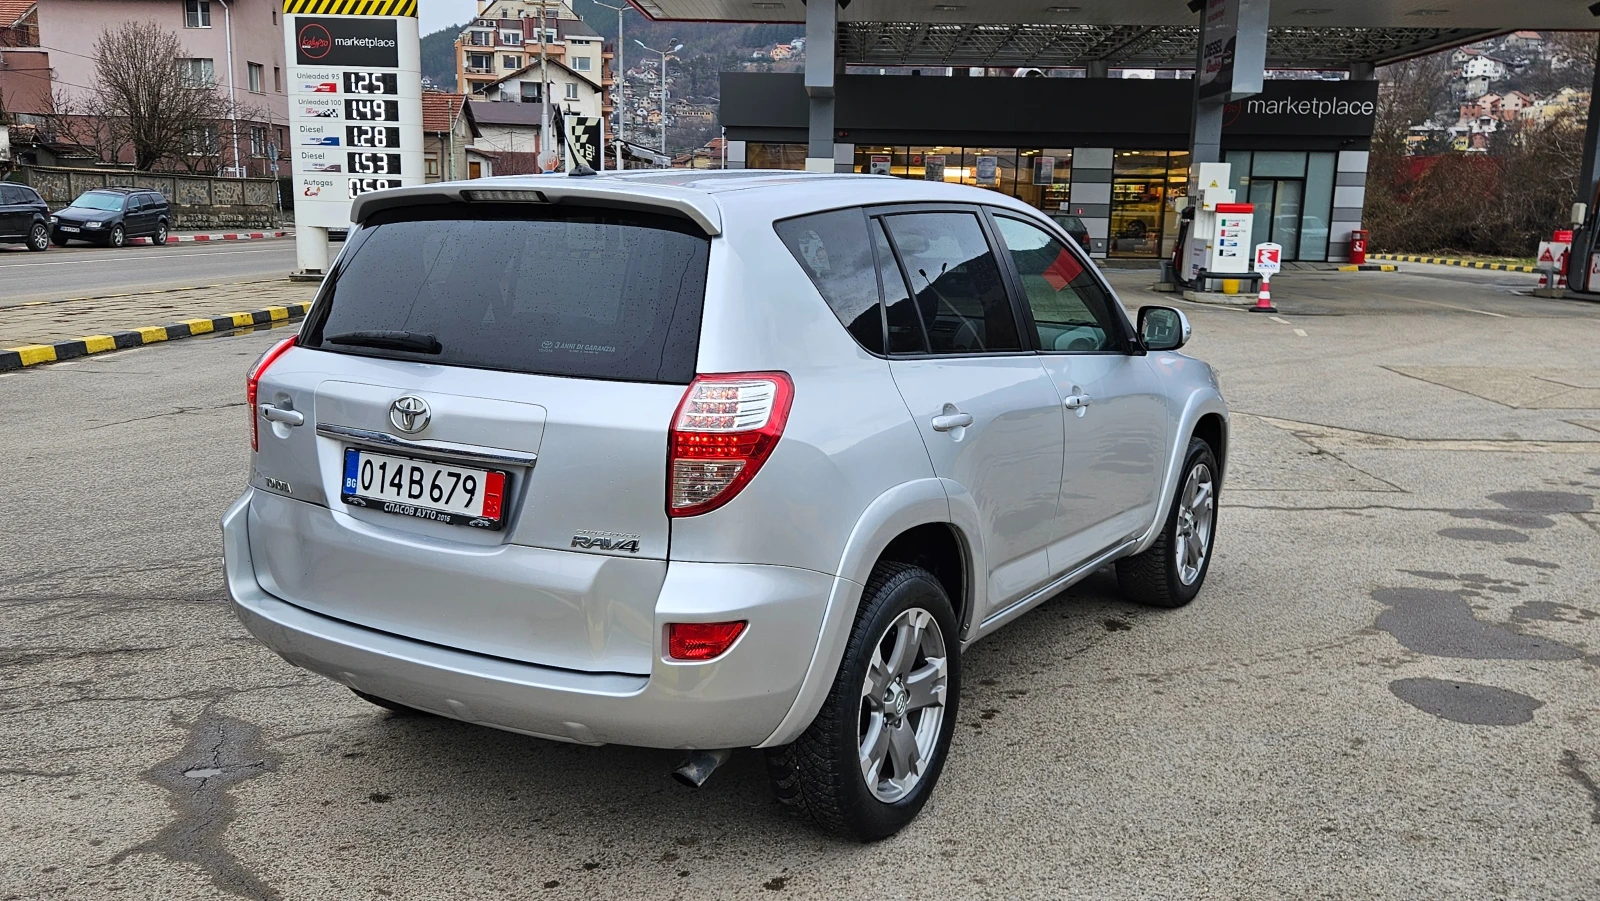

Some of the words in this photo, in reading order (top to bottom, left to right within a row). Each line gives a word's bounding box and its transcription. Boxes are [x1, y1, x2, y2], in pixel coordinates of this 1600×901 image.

[335, 37, 395, 48] marketplace
[1247, 96, 1374, 118] marketplace
[302, 152, 325, 160] Diesel
[304, 179, 333, 187] Autogas
[555, 341, 560, 349] 3
[346, 477, 357, 488] BG
[361, 459, 477, 508] 014B679
[384, 502, 415, 516] СПАСОВ
[416, 508, 437, 520] АУТО
[437, 513, 451, 523] 2016
[570, 535, 641, 553] RAV4
